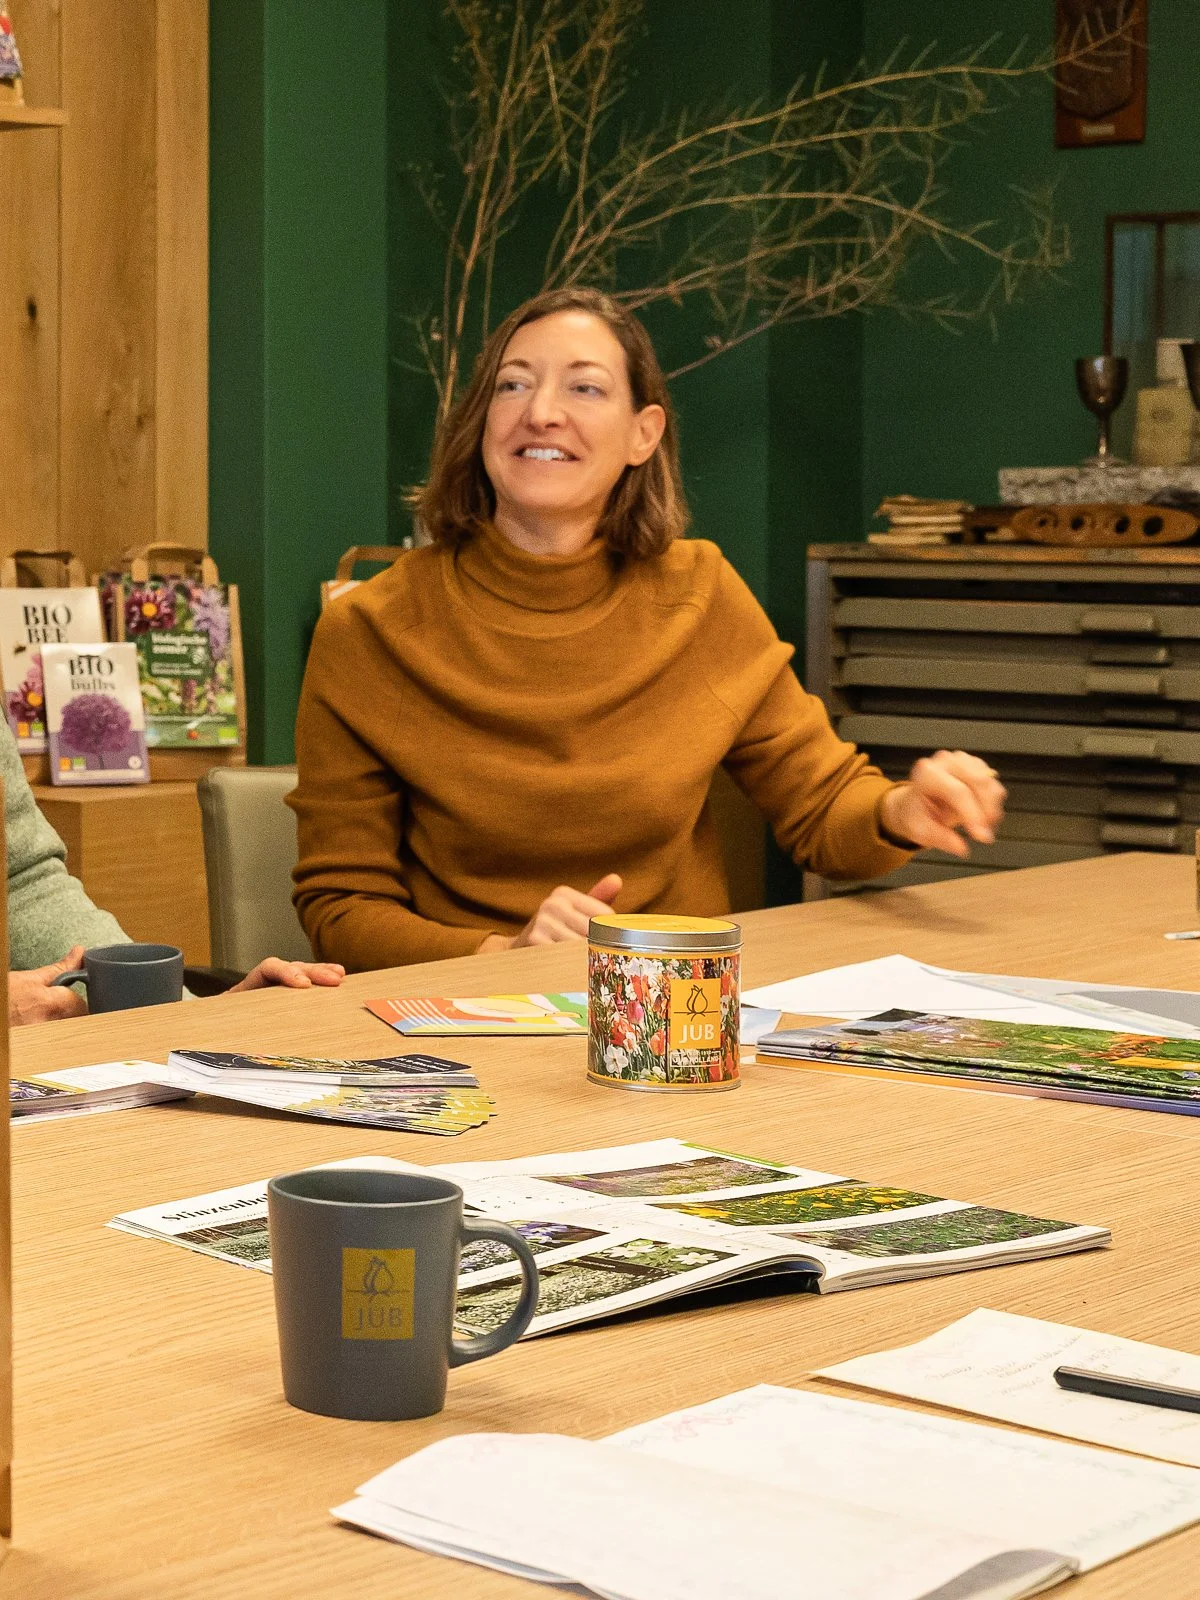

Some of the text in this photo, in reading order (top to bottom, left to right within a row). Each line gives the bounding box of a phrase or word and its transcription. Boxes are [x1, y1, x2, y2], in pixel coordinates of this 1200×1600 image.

[23, 605, 72, 626] BIO
[27, 627, 69, 643] BEE
[678, 1024, 715, 1044] JUB
[161, 1193, 268, 1220] Stinzenbo
[354, 1306, 402, 1334] JUB
